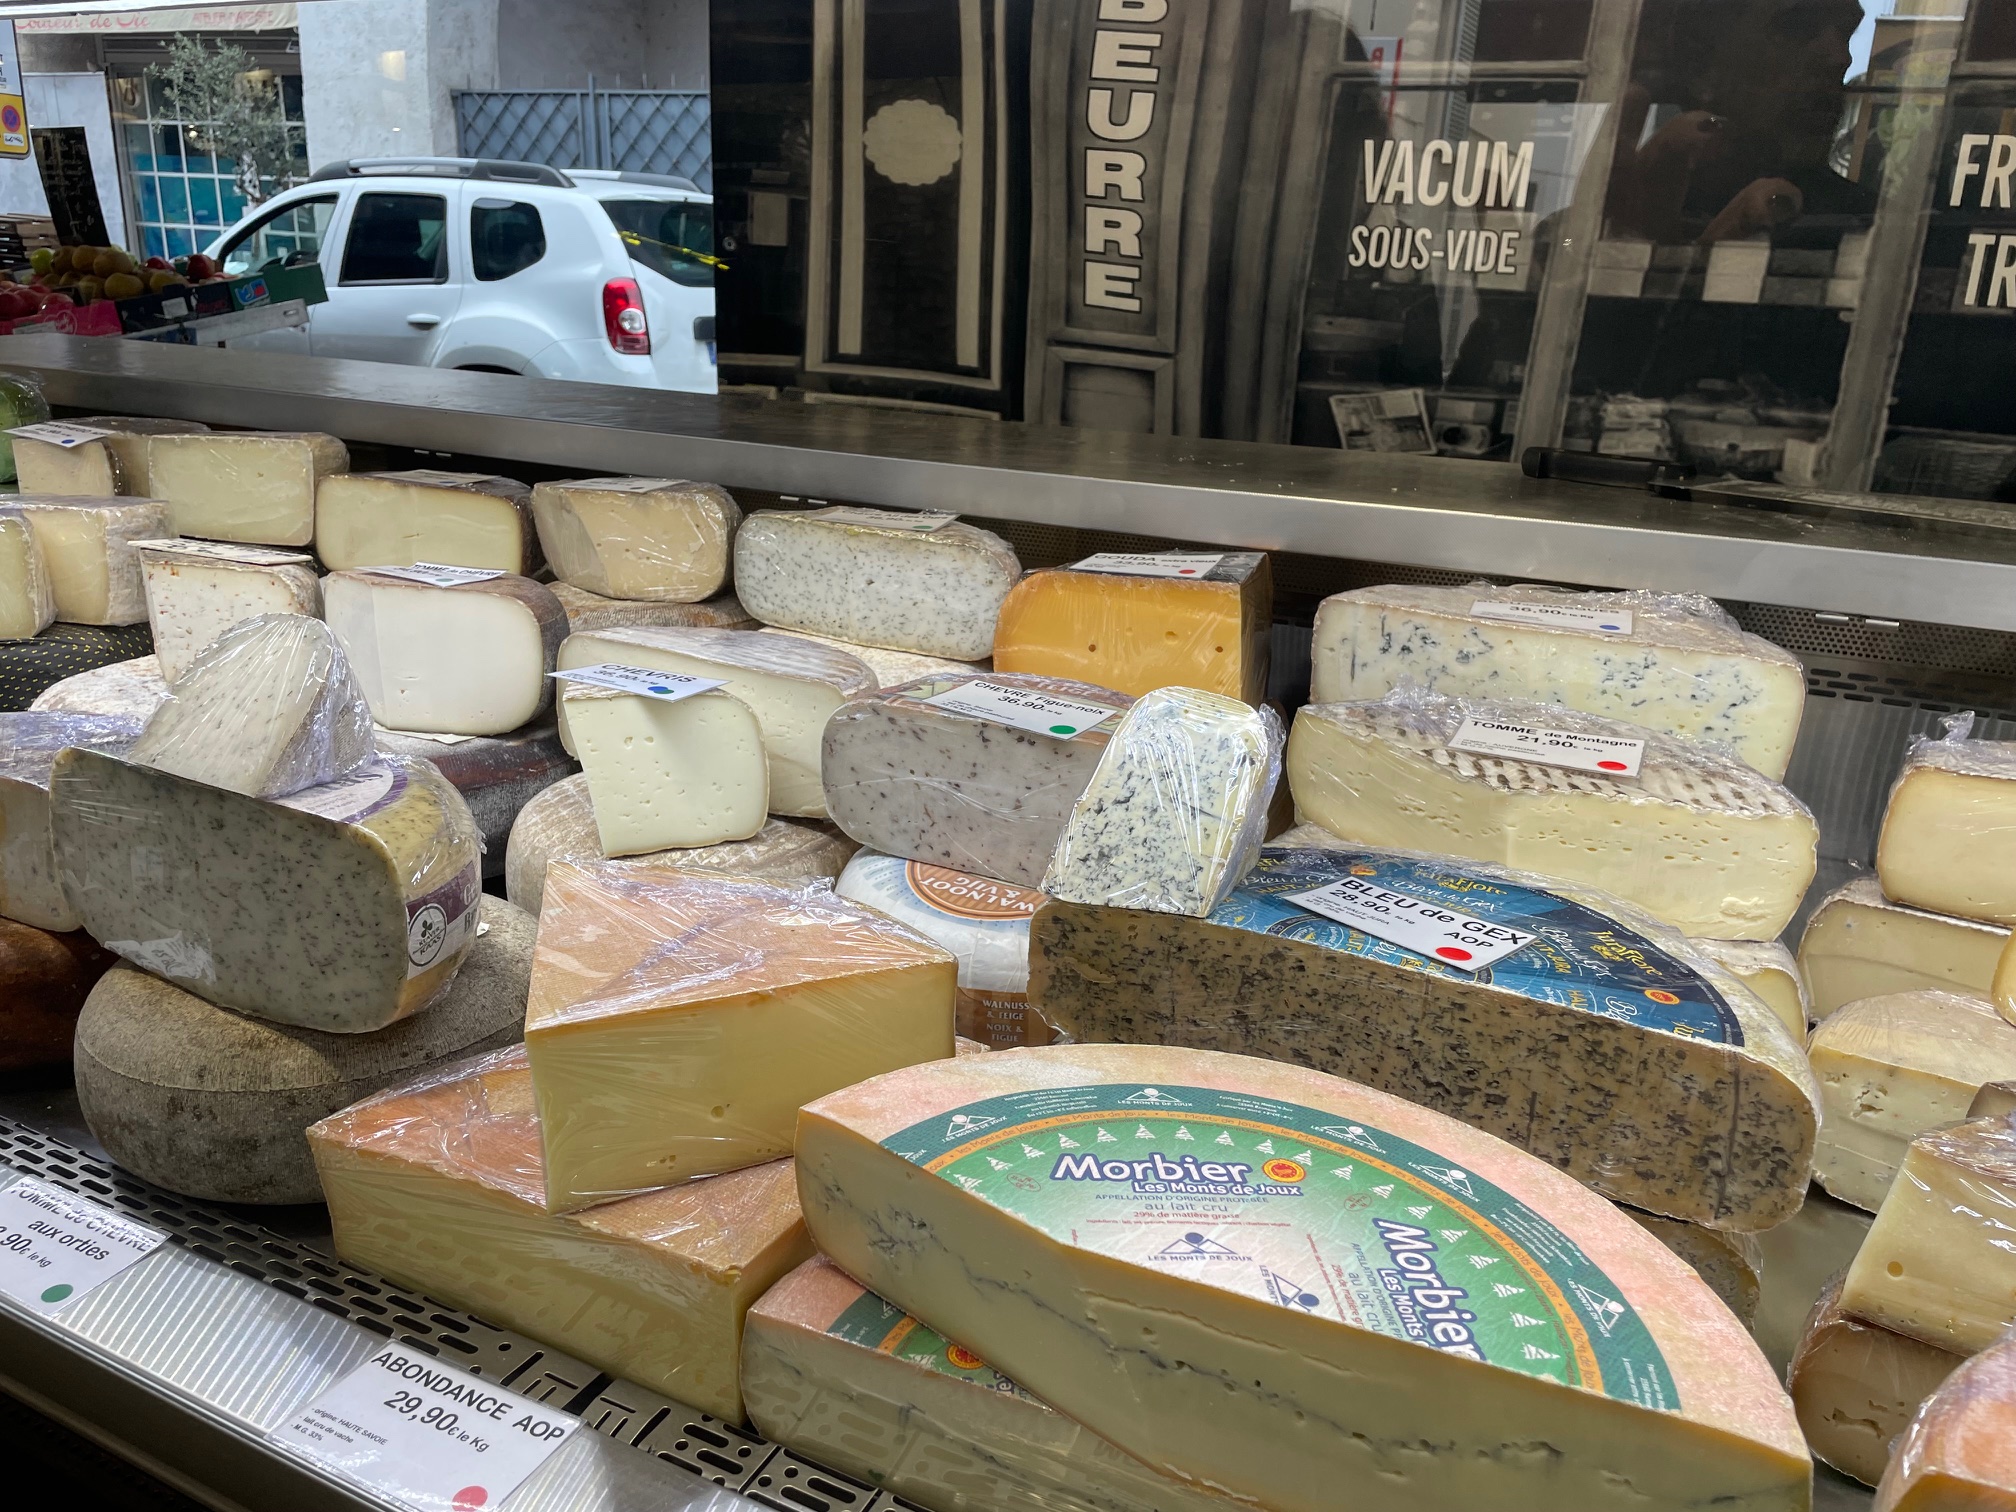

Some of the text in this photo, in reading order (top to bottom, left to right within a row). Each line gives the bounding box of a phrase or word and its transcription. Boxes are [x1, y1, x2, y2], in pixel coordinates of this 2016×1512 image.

[1363, 138, 1535, 208] VACUM
[1949, 133, 2016, 208] FR
[1348, 224, 1521, 274] SOUS-VIDE
[1964, 233, 2016, 307] TR
[1094, 553, 1156, 562] GOUDA
[601, 664, 698, 683] CHEVRIS
[974, 681, 1034, 699] CHEVRE
[1034, 695, 1108, 716] Figue-noix
[1471, 720, 1638, 748] TOMME de Montagne
[920, 876, 1035, 913] WALNOOT
[1339, 879, 1420, 909] BLEU
[1420, 905, 1456, 924] de
[1461, 920, 1528, 946] GEX
[1443, 930, 1495, 949] AOP
[982, 999, 1030, 1010] WALNUSS
[986, 1009, 1025, 1021] & FEIGE
[986, 1022, 1024, 1033] NOIX &
[991, 1032, 1019, 1042] FIGUE
[969, 1134, 1001, 1147] Monts
[1002, 1129, 1015, 1137] de
[1297, 1133, 1332, 1148] Monts
[1053, 1153, 1251, 1182] Morbier
[1133, 1181, 1301, 1195] Les Monts de Joux
[1165, 1194, 1218, 1202] D'ORIGINE
[1144, 1203, 1164, 1211] au
[1171, 1202, 1196, 1211] lait
[1172, 1211, 1210, 1219] matière
[28, 1220, 110, 1261] aux orties
[26, 1251, 53, 1268] le kg
[1258, 1264, 1271, 1277] LES
[1351, 1242, 1379, 1288] APPELLATION
[1348, 1272, 1384, 1332] au lait cru
[1376, 1219, 1484, 1361] Morbier
[1378, 1269, 1404, 1292] Les
[1391, 1294, 1425, 1338] Monts
[371, 1351, 566, 1442] ABONDANCE AOP
[303, 1416, 316, 1425] lait
[313, 1421, 325, 1430] cru
[334, 1430, 354, 1443] vache
[339, 1418, 363, 1433] HAUTE
[361, 1429, 389, 1445] SAVOIE
[383, 1390, 490, 1453] 29,90€ le Kg
